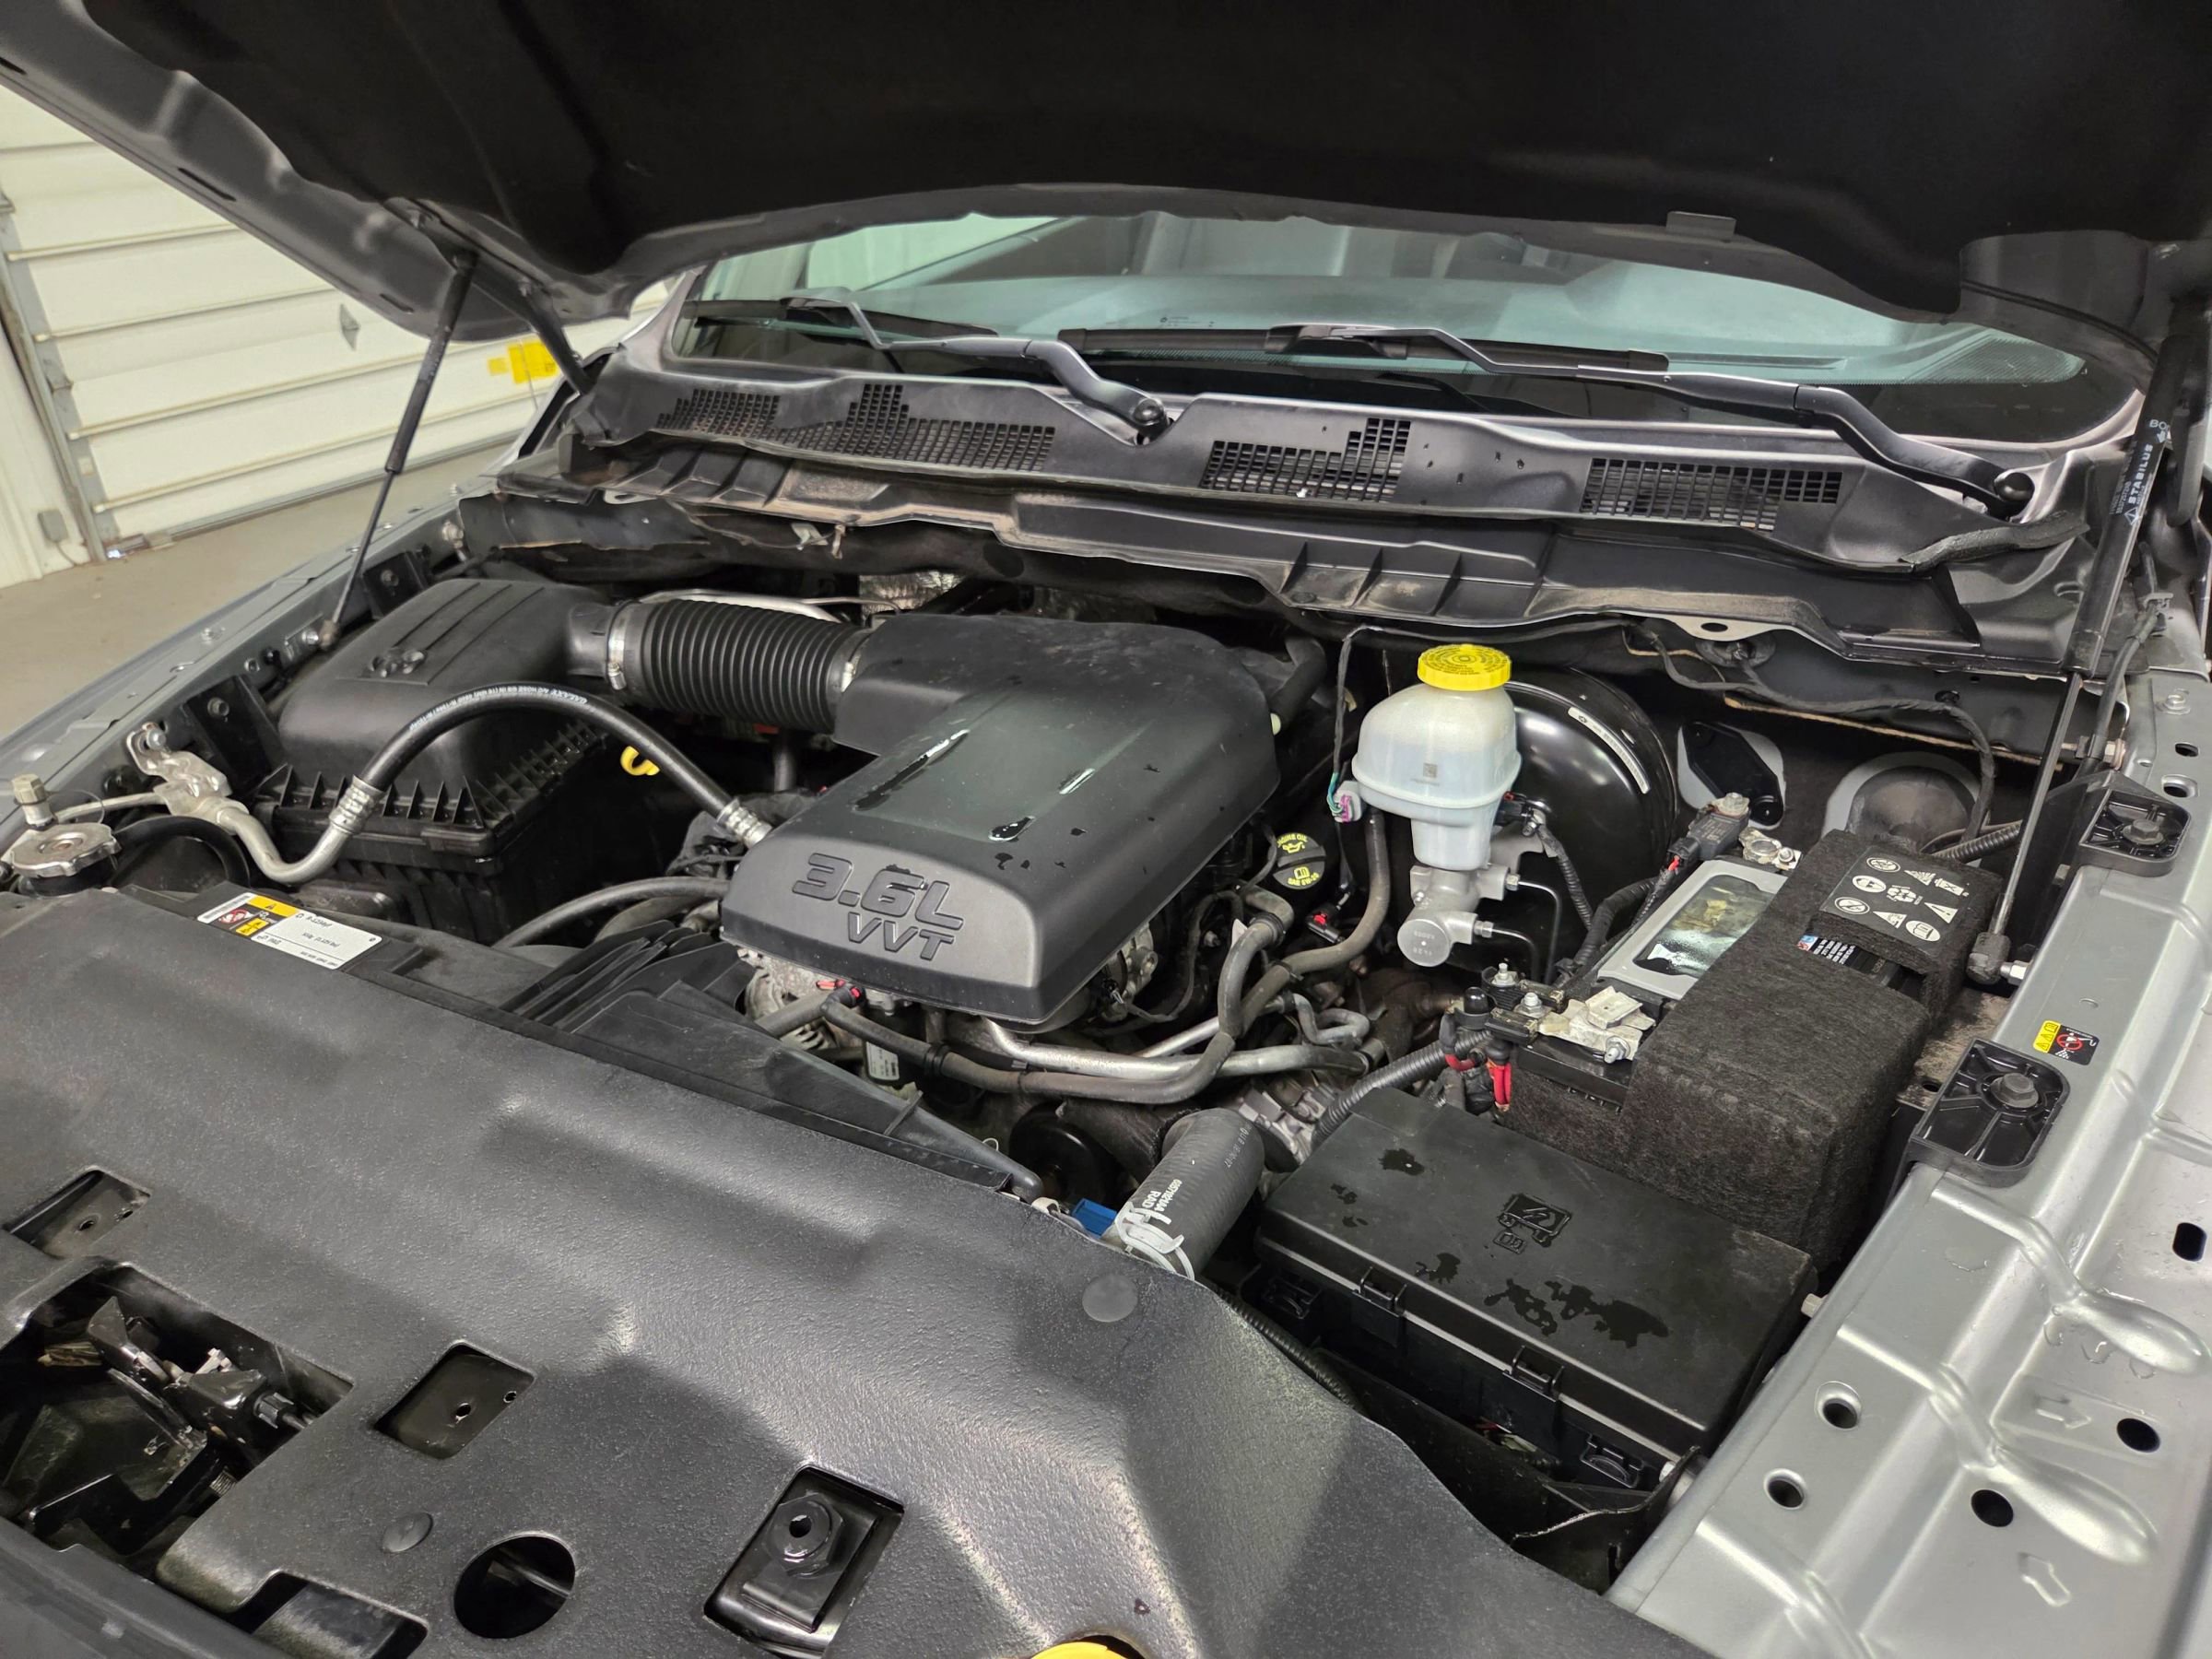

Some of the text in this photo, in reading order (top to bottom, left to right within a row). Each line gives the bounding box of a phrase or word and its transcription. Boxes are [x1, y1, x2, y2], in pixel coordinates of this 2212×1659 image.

[2128, 444, 2154, 504] STABILUS
[792, 852, 964, 931] 3.6L
[847, 912, 955, 960] VVT
[1141, 1190, 1161, 1208] RAD
